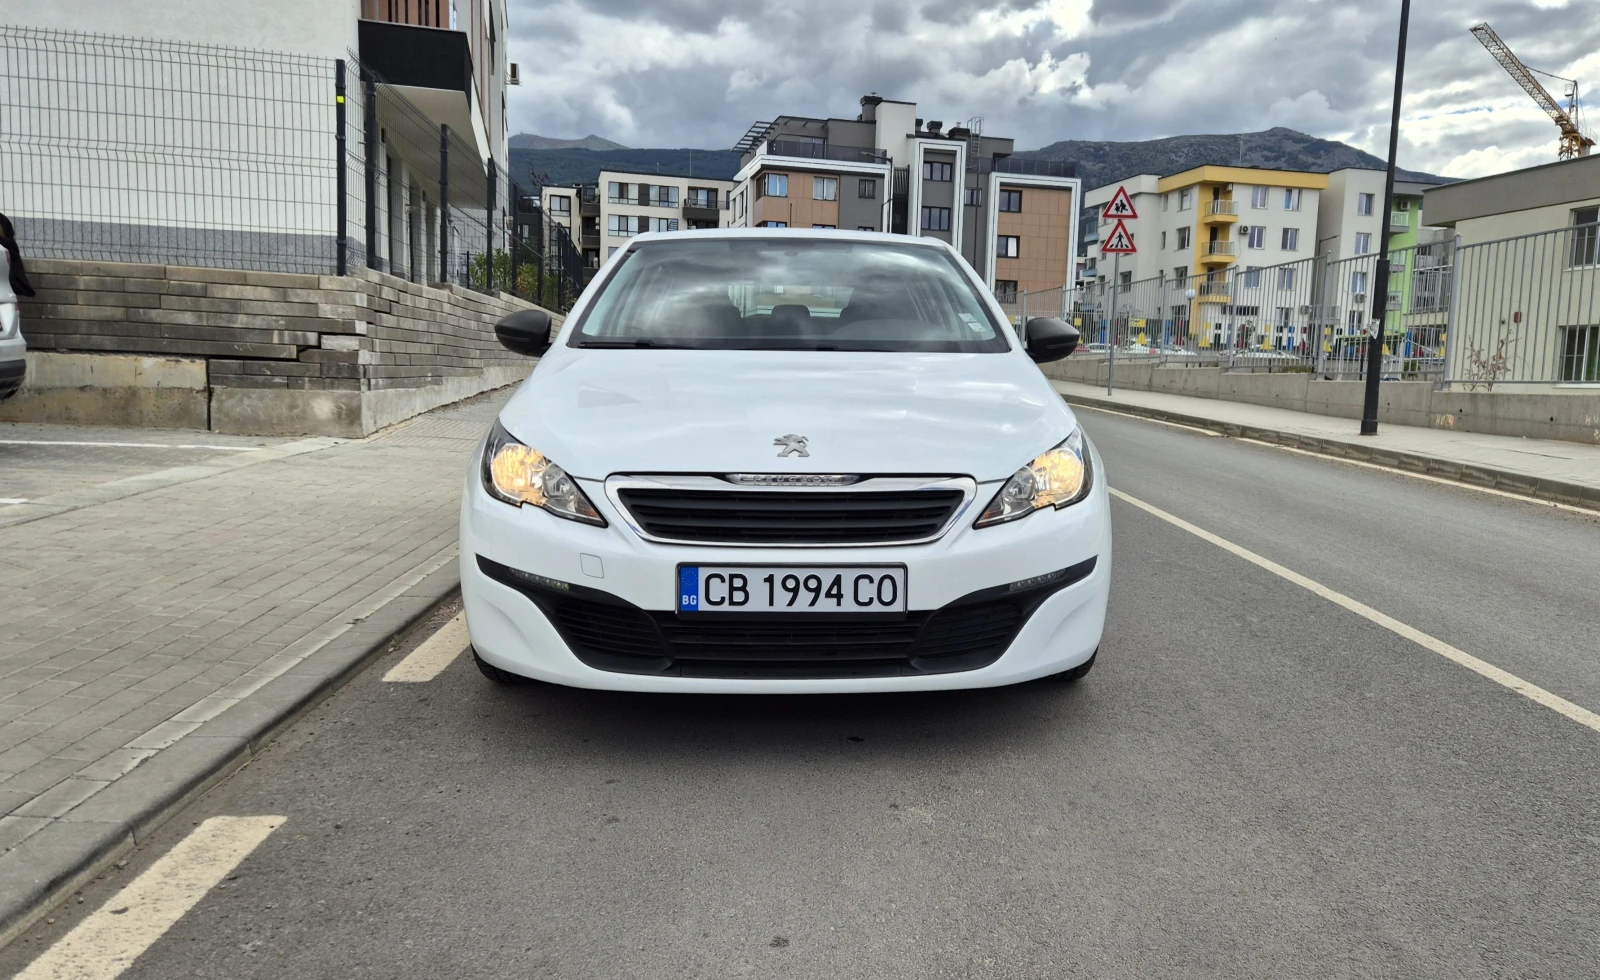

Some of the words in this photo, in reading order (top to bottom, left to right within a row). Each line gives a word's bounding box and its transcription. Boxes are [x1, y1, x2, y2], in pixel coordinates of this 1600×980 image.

[682, 594, 697, 606] BG
[704, 573, 750, 607] CB
[763, 573, 844, 607] 1994
[853, 573, 898, 607] CO
